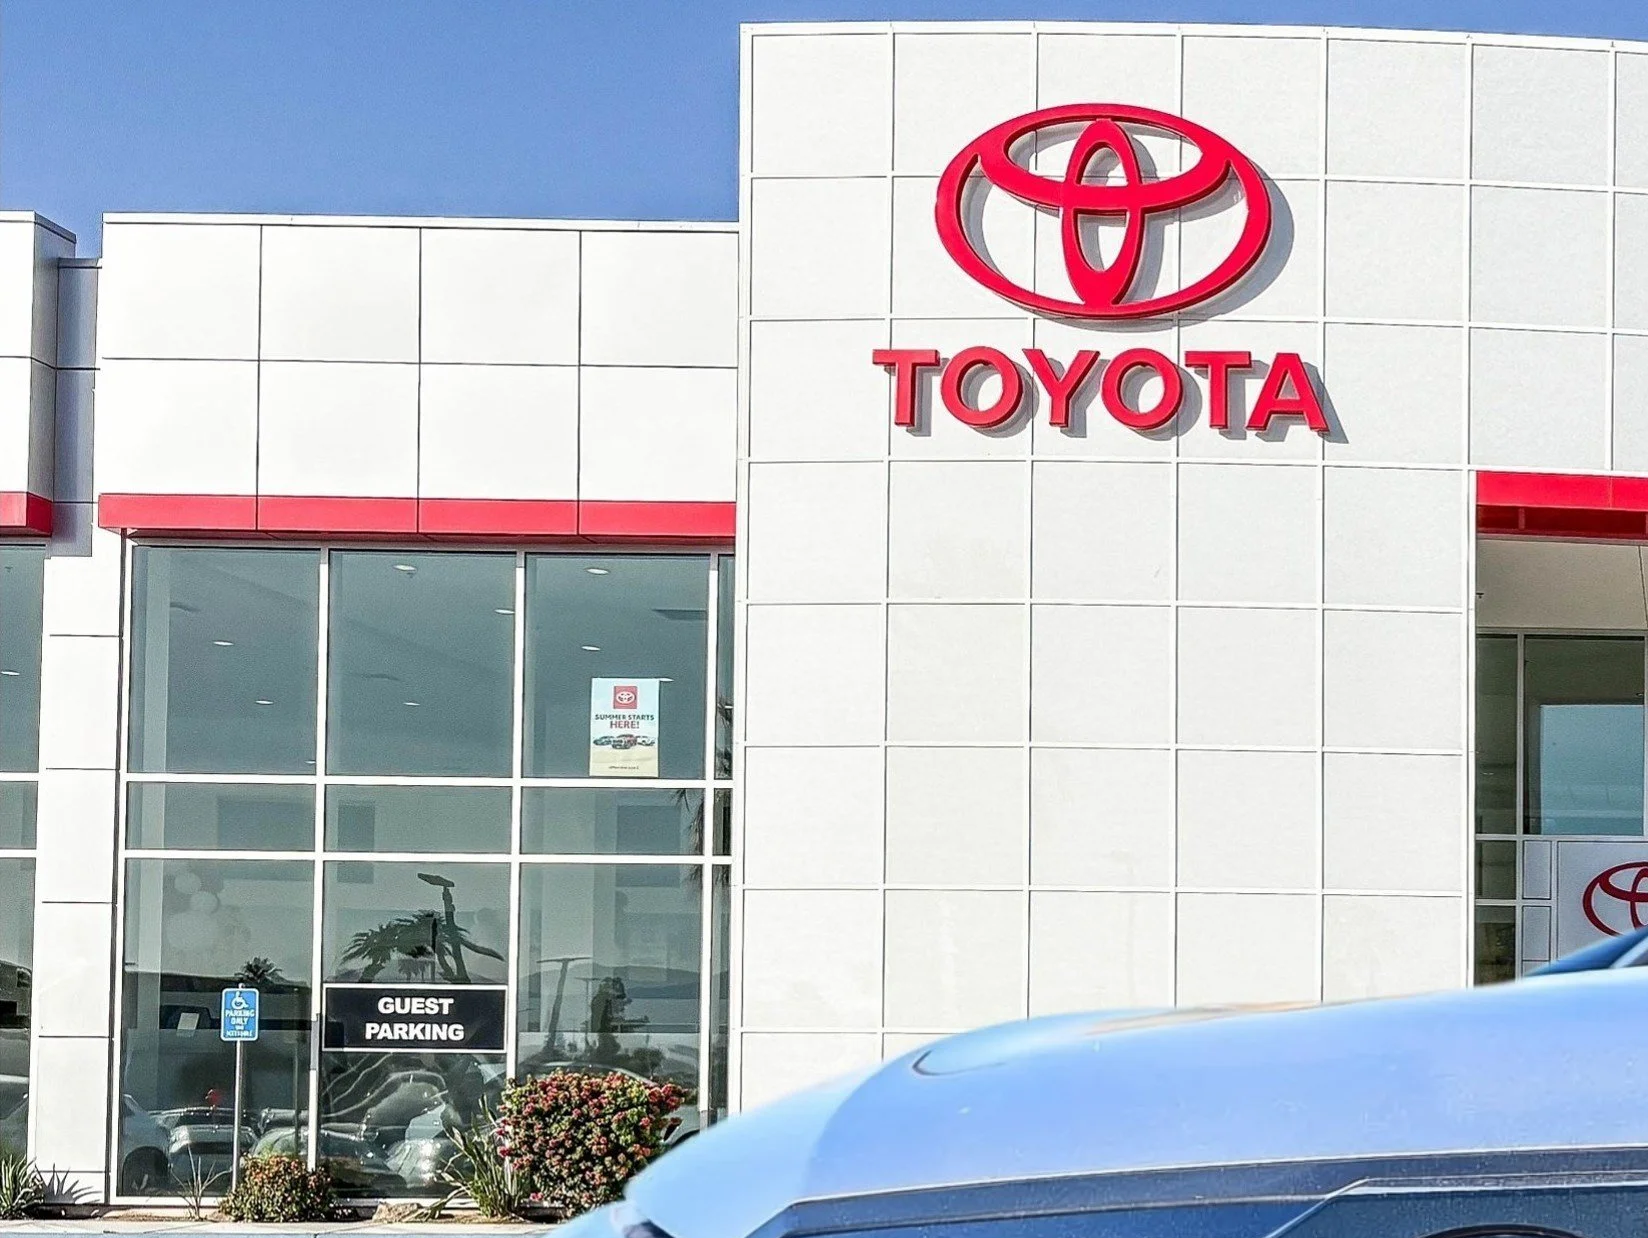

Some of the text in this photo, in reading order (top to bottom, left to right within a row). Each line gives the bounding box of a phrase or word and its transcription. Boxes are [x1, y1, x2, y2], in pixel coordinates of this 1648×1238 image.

[872, 345, 1329, 434] TOYOTA
[610, 720, 640, 729] HERE!
[377, 996, 454, 1015] GUEST
[365, 1022, 464, 1041] PARKING
